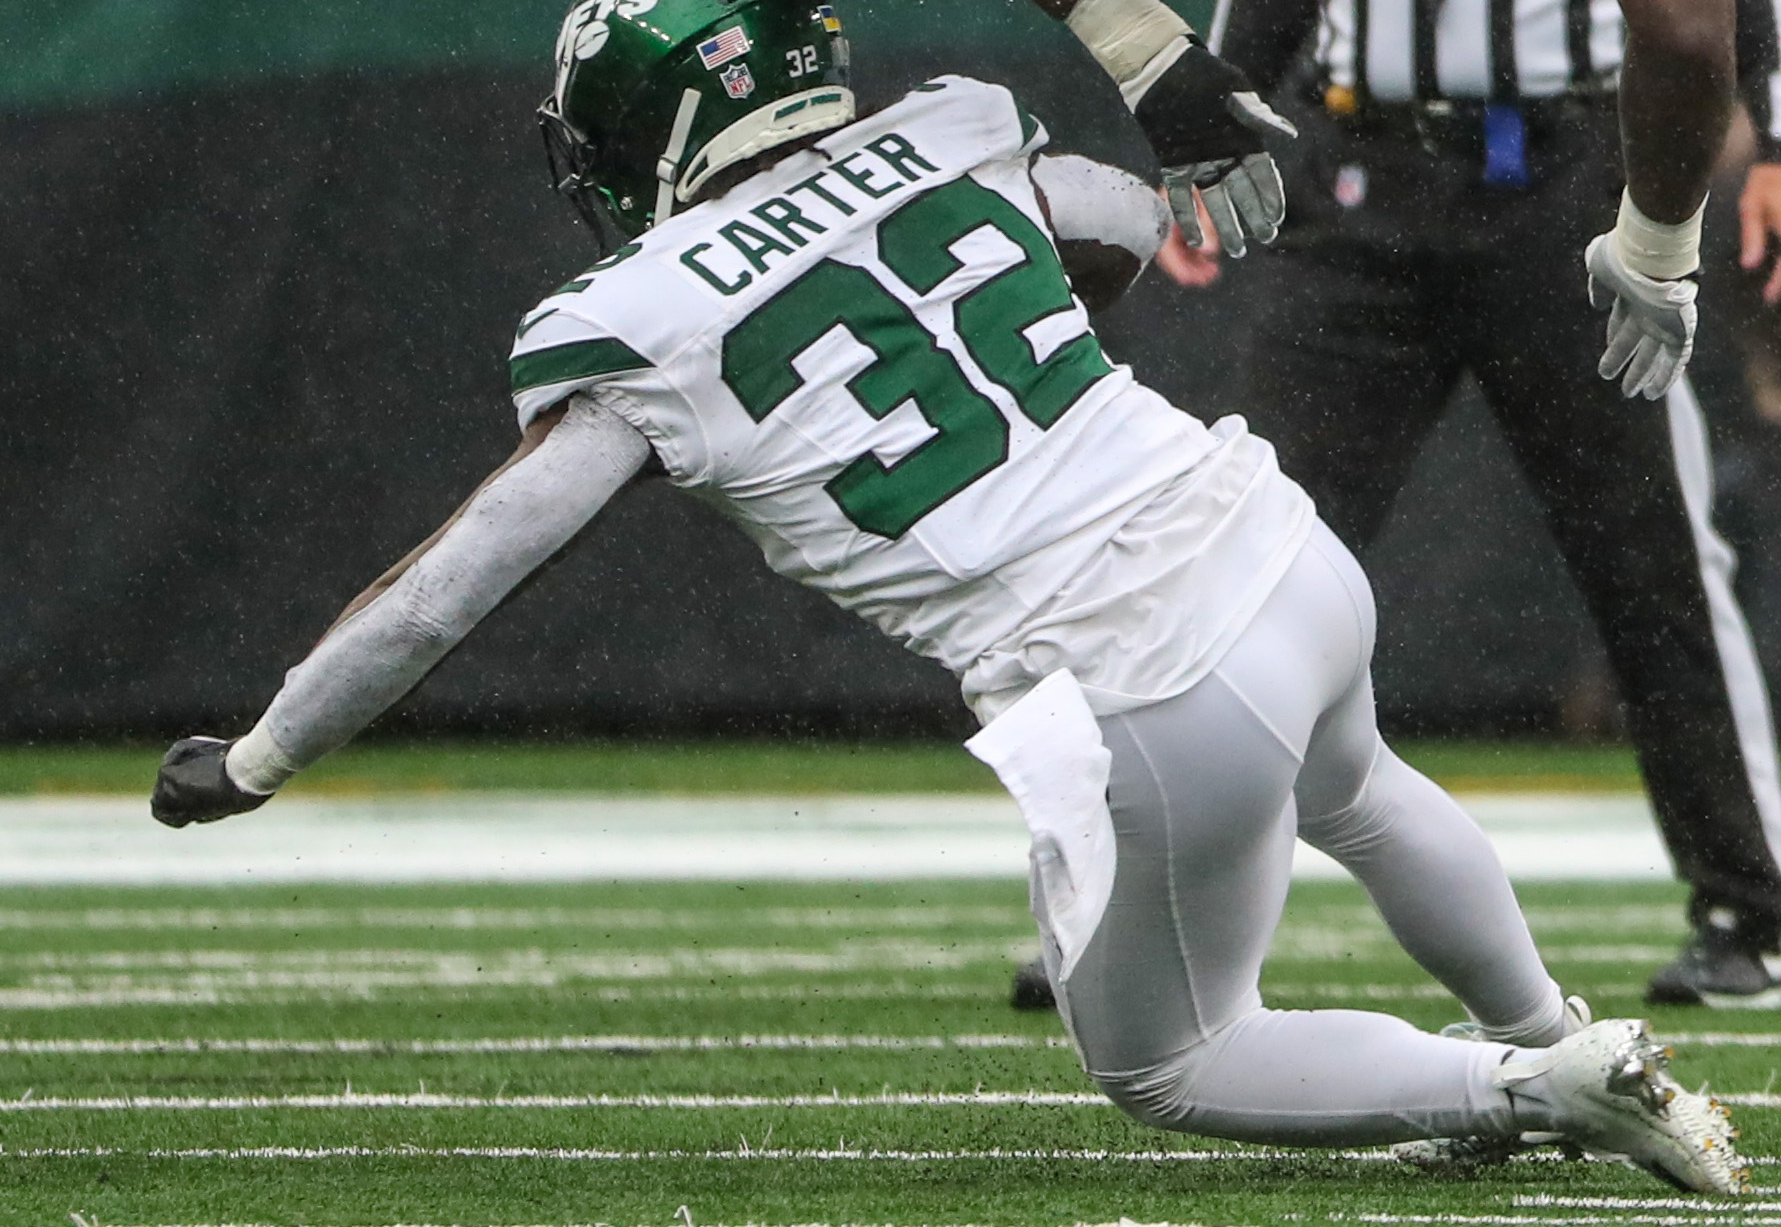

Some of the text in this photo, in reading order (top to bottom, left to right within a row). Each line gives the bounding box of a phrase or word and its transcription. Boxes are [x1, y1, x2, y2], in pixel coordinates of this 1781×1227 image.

[729, 78, 754, 95] NFL
[785, 44, 819, 79] 32
[680, 132, 941, 297] CARTER
[721, 174, 1118, 541] 32
